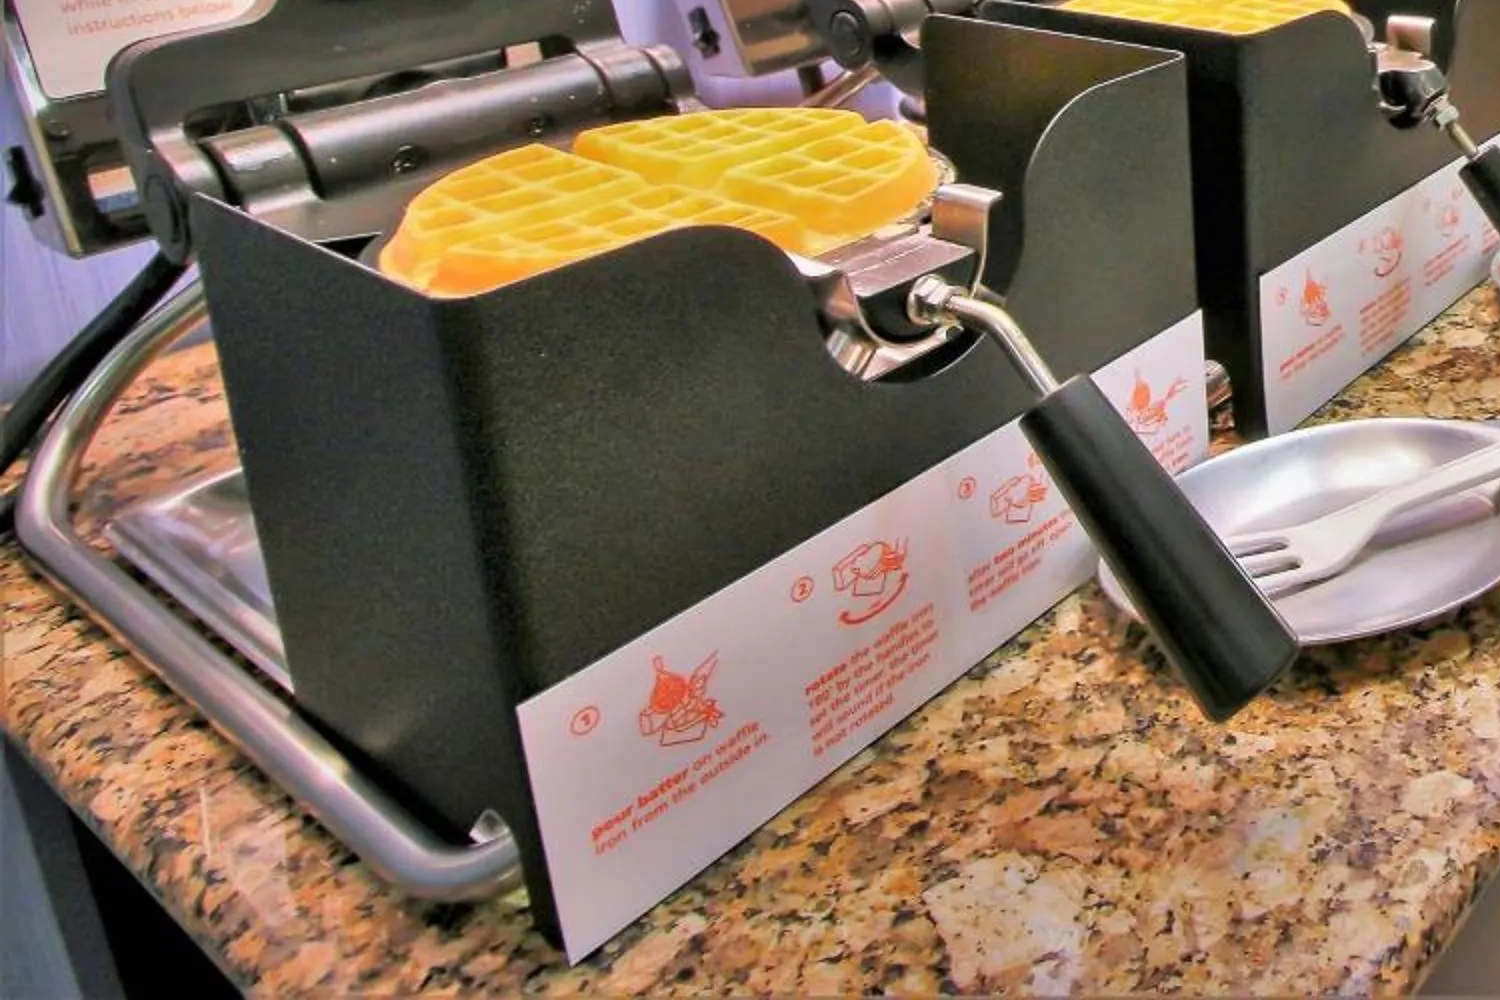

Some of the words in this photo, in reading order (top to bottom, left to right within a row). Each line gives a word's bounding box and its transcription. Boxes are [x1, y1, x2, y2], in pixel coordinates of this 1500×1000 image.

[66, 9, 174, 36] instructions
[805, 663, 848, 696] rotate
[592, 804, 634, 841] pour
[692, 753, 712, 771] on
[715, 721, 760, 755] waffle
[631, 802, 669, 830] from
[671, 781, 697, 804] the
[700, 744, 751, 784] outside
